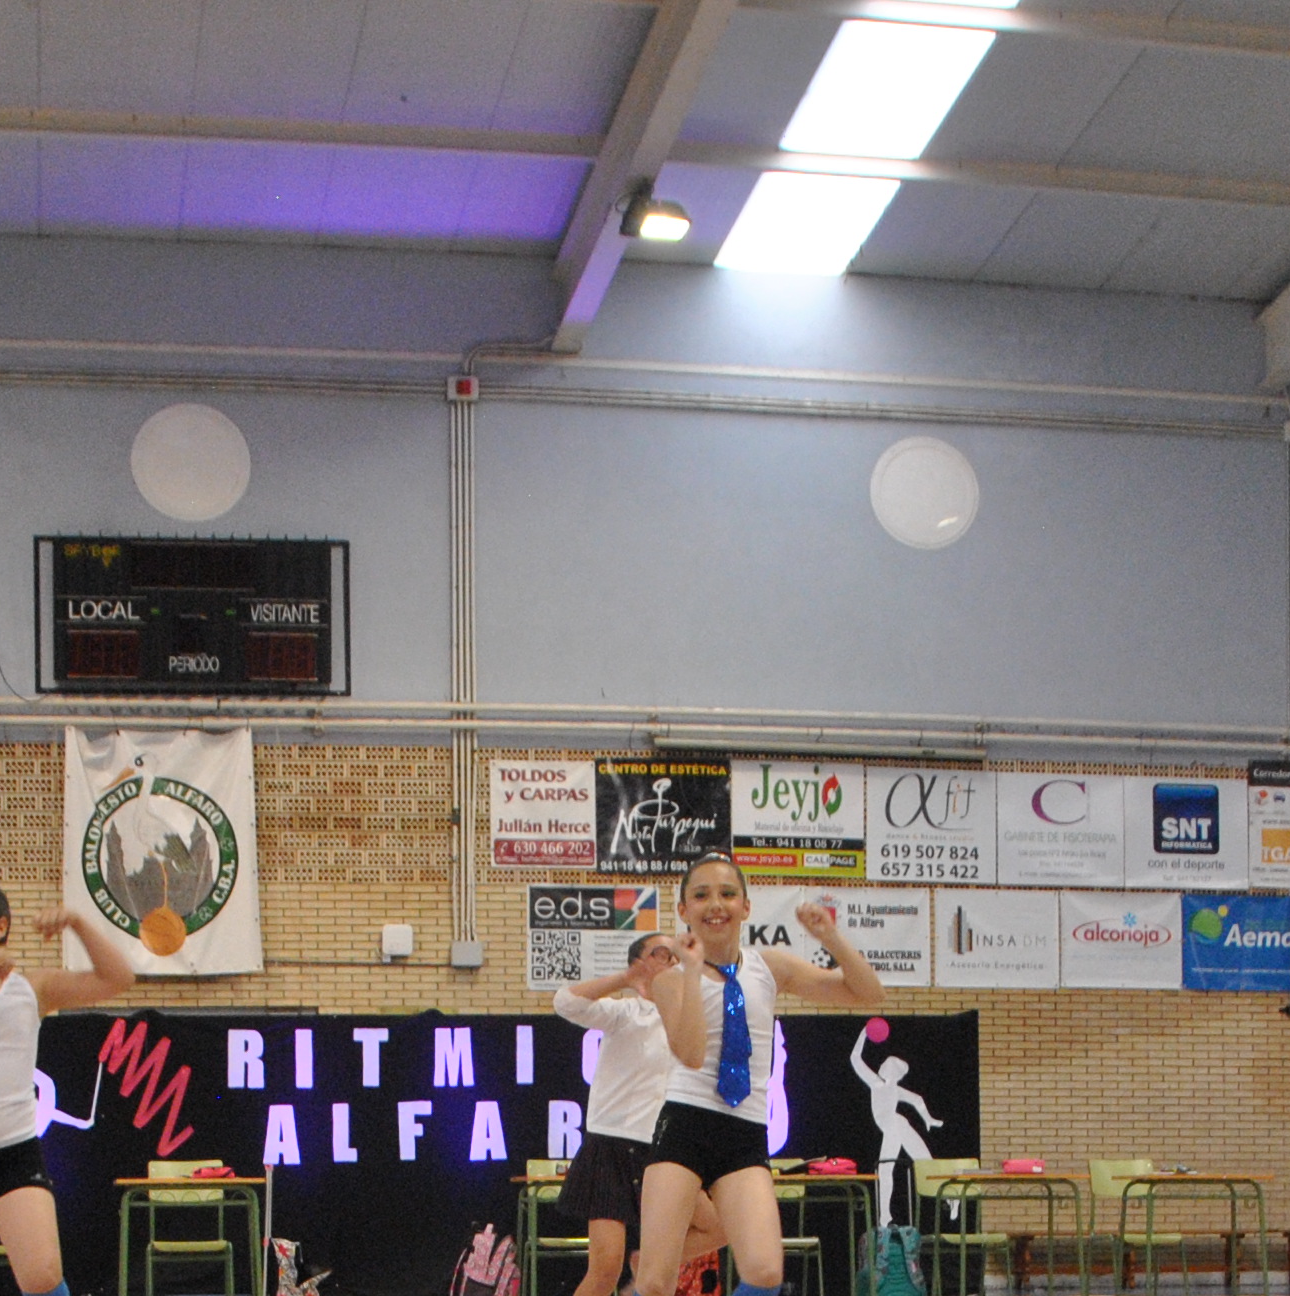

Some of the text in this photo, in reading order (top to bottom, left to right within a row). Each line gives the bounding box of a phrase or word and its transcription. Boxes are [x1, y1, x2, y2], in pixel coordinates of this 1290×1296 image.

[67, 600, 140, 620] LOCAL
[250, 603, 320, 623] VISITANTE
[168, 655, 220, 673] PERIODO
[499, 767, 567, 782] TOLDOS
[598, 763, 648, 775] CENTRO
[650, 763, 667, 775] DE
[1253, 767, 1290, 778] Corredor
[504, 787, 589, 803] y CARPAS
[548, 818, 591, 833] Herce
[1161, 816, 1212, 841] SNT
[799, 838, 812, 848] 18
[831, 839, 843, 849] 77
[1047, 831, 1059, 843] DE
[84, 781, 224, 928] CLUB BALONESTO ALFARO
[513, 841, 591, 855] 630 466 202
[880, 844, 979, 861] 619 507 824
[880, 861, 979, 879] 657 315 422
[1147, 858, 1226, 871] con el deporte
[534, 890, 611, 920] e.d.s
[743, 924, 792, 946] KA
[976, 934, 1017, 948] INSA
[867, 949, 922, 960] GRACCURRIS
[893, 961, 915, 972] SALA
[227, 1024, 605, 1090] RITMIC
[262, 1099, 583, 1166] ALFAR
